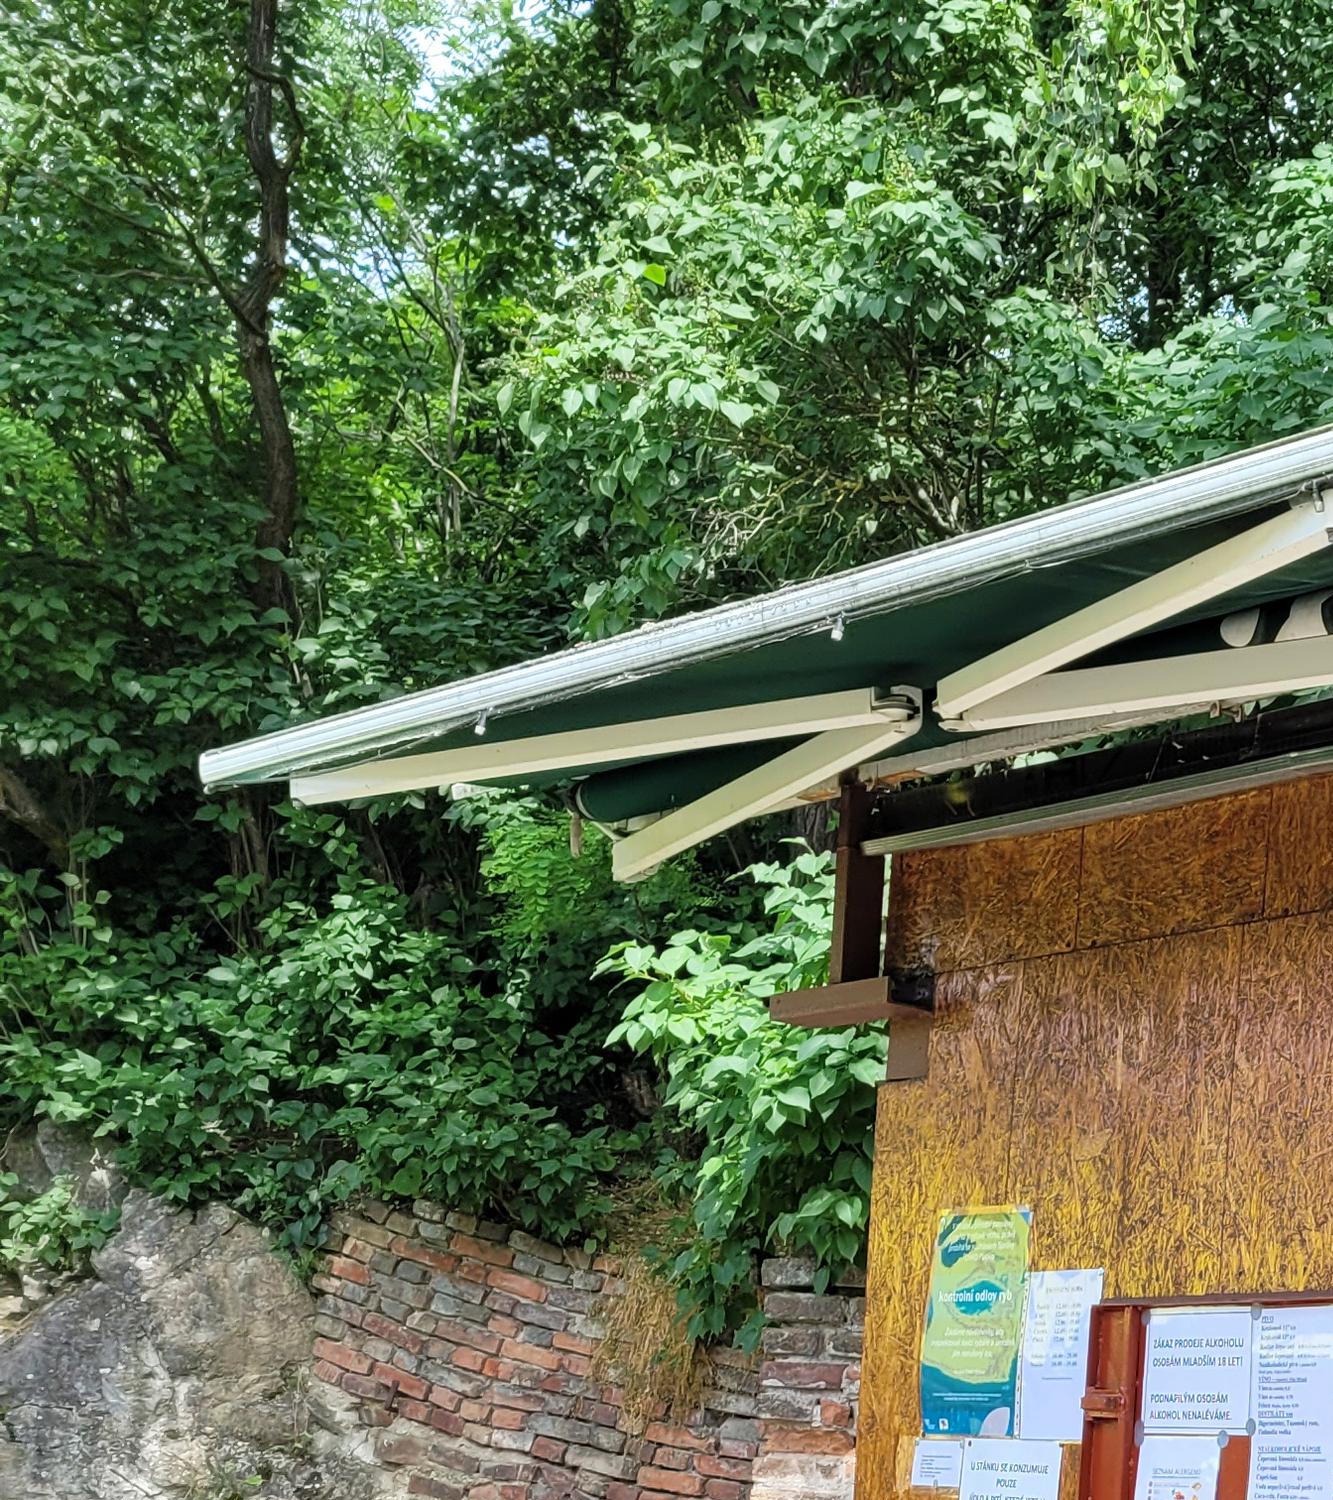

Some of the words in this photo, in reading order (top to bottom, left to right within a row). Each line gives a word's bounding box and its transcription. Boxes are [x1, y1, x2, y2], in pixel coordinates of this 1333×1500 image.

[939, 1289, 973, 1303] kontrolní
[976, 1290, 998, 1302] odlov
[999, 1291, 1012, 1303] ryb
[1154, 1336, 1172, 1348] ZÁKAZ
[1175, 1338, 1203, 1348] PRODEJE
[1205, 1338, 1244, 1348] ALKOHOLU
[1153, 1356, 1180, 1367] OSOBÁM
[1183, 1355, 1216, 1367] MLADŠÍM
[1218, 1357, 1226, 1366] 18
[1151, 1392, 1195, 1403] PODNAPILÝM
[1197, 1392, 1228, 1403] OSOBÁM
[1150, 1410, 1180, 1420] ALKOHOL
[971, 1461, 976, 1470] U
[976, 1460, 999, 1471] STÁNKU
[1000, 1462, 1008, 1472] SE
[1009, 1463, 1049, 1474] KONZUMUJE
[996, 1478, 1017, 1488] POUZE
